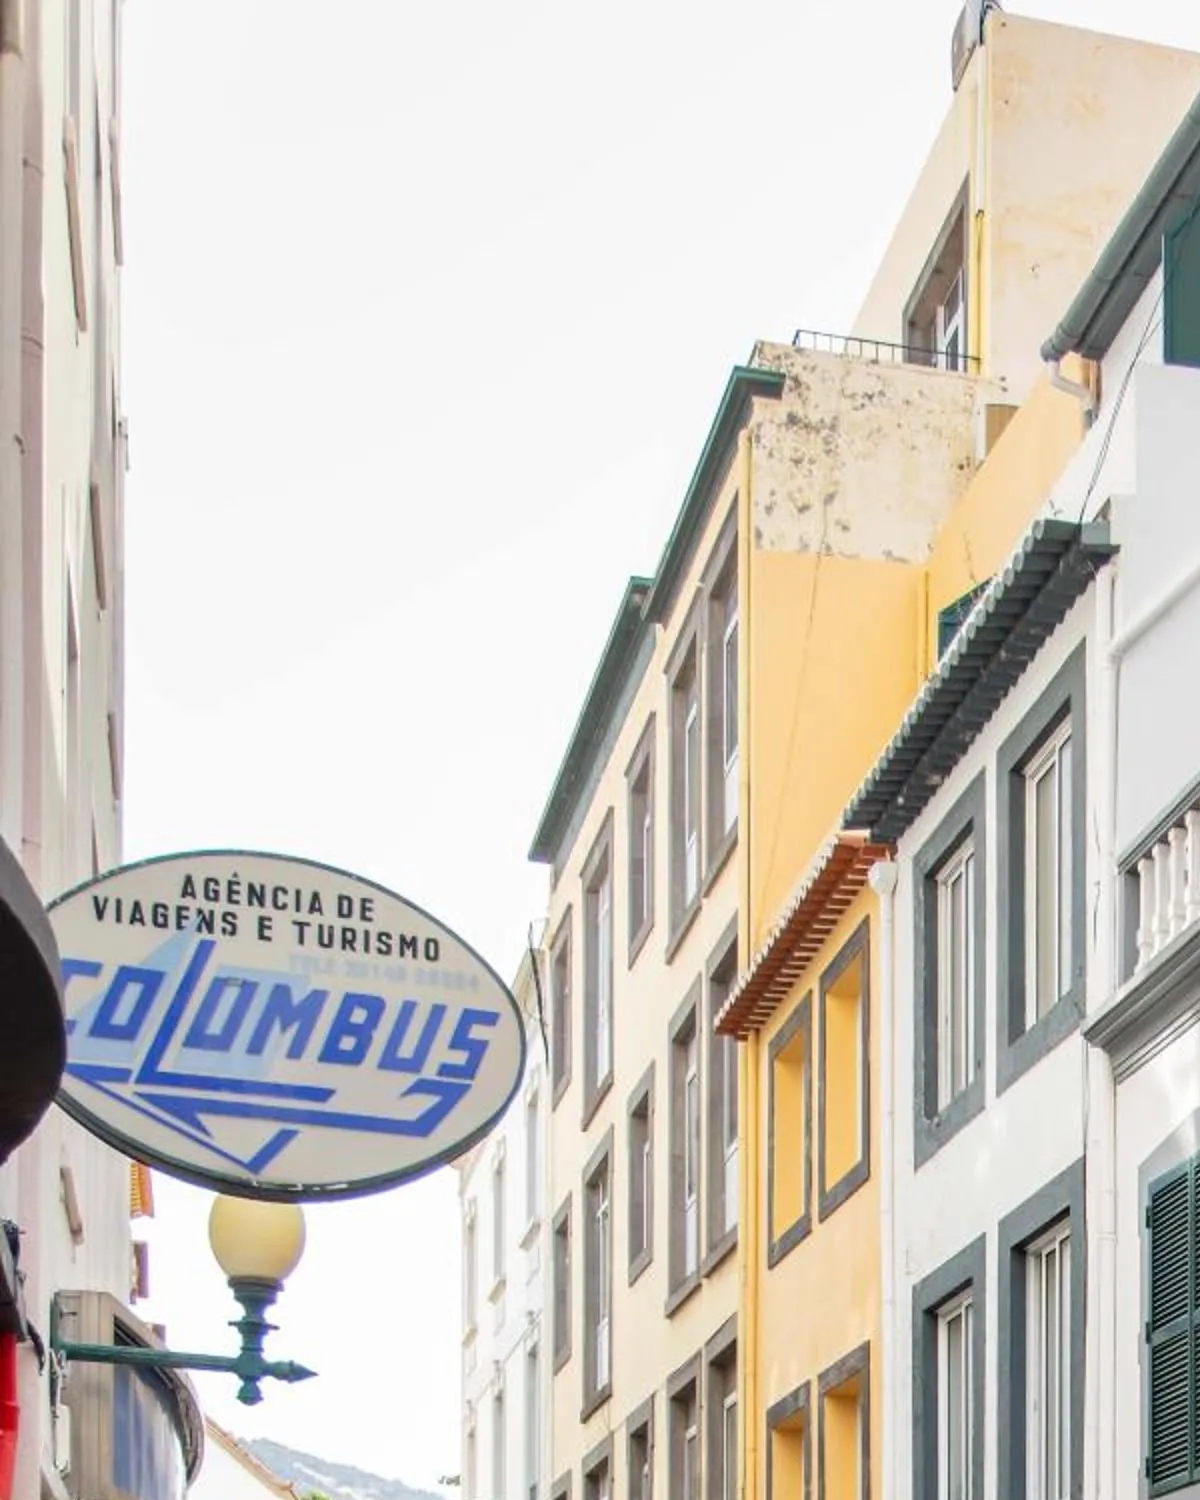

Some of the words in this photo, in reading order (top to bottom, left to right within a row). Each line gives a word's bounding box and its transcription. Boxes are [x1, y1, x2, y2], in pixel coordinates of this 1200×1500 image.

[180, 872, 324, 915] AGÊNCIA
[336, 895, 376, 922] DE
[92, 895, 239, 937] VIAGENS
[257, 915, 274, 941] E
[292, 921, 441, 962] TURISMO
